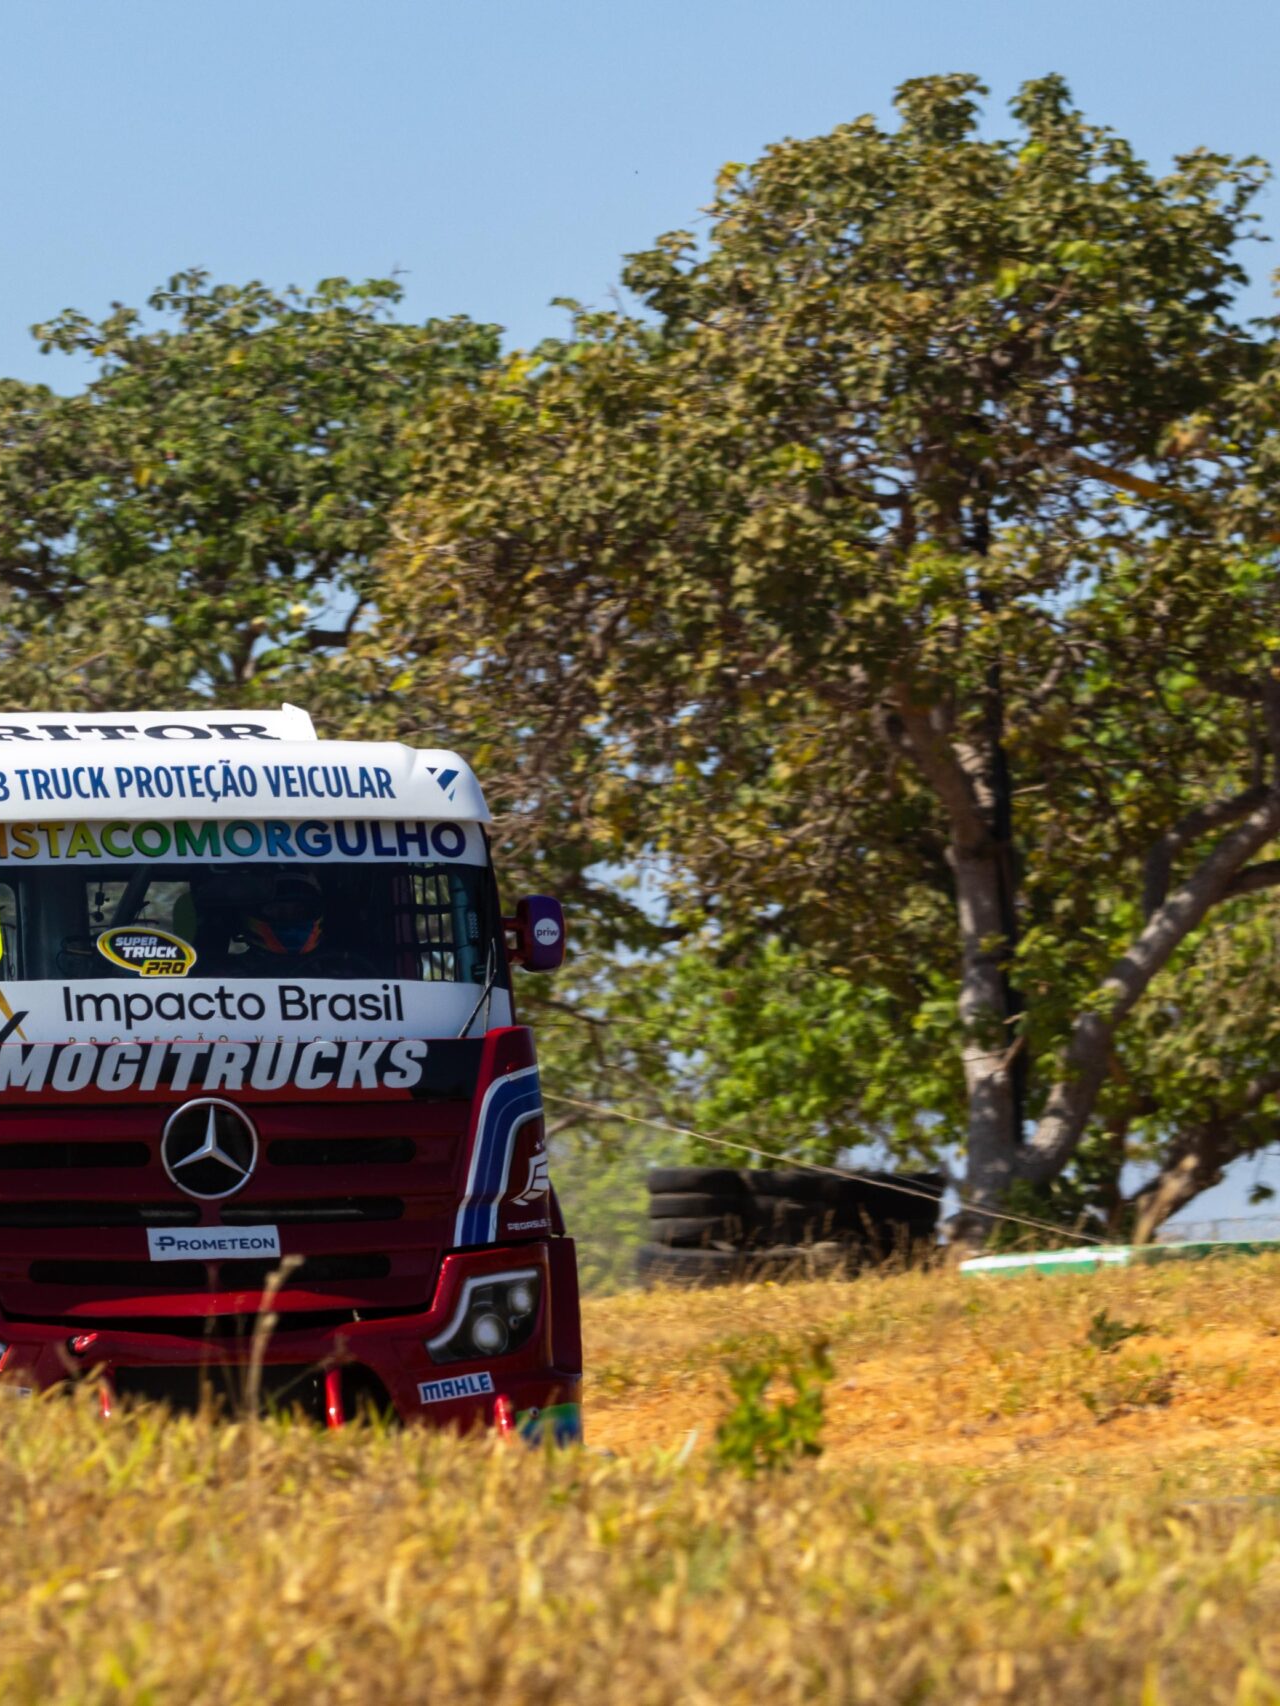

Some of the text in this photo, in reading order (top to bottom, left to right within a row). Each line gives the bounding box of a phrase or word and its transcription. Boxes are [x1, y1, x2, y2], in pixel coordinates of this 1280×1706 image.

[15, 768, 111, 800] TRUCK
[114, 760, 258, 803] PROTEÇÃO
[262, 765, 397, 799] VEICULAR
[115, 937, 158, 947] SUPER
[122, 946, 179, 958] TRUCK
[146, 961, 187, 975] PRO
[63, 984, 404, 1030] Impacto Brasil
[154, 1236, 275, 1251] PROMETEON
[422, 1373, 492, 1401] MAHLE
